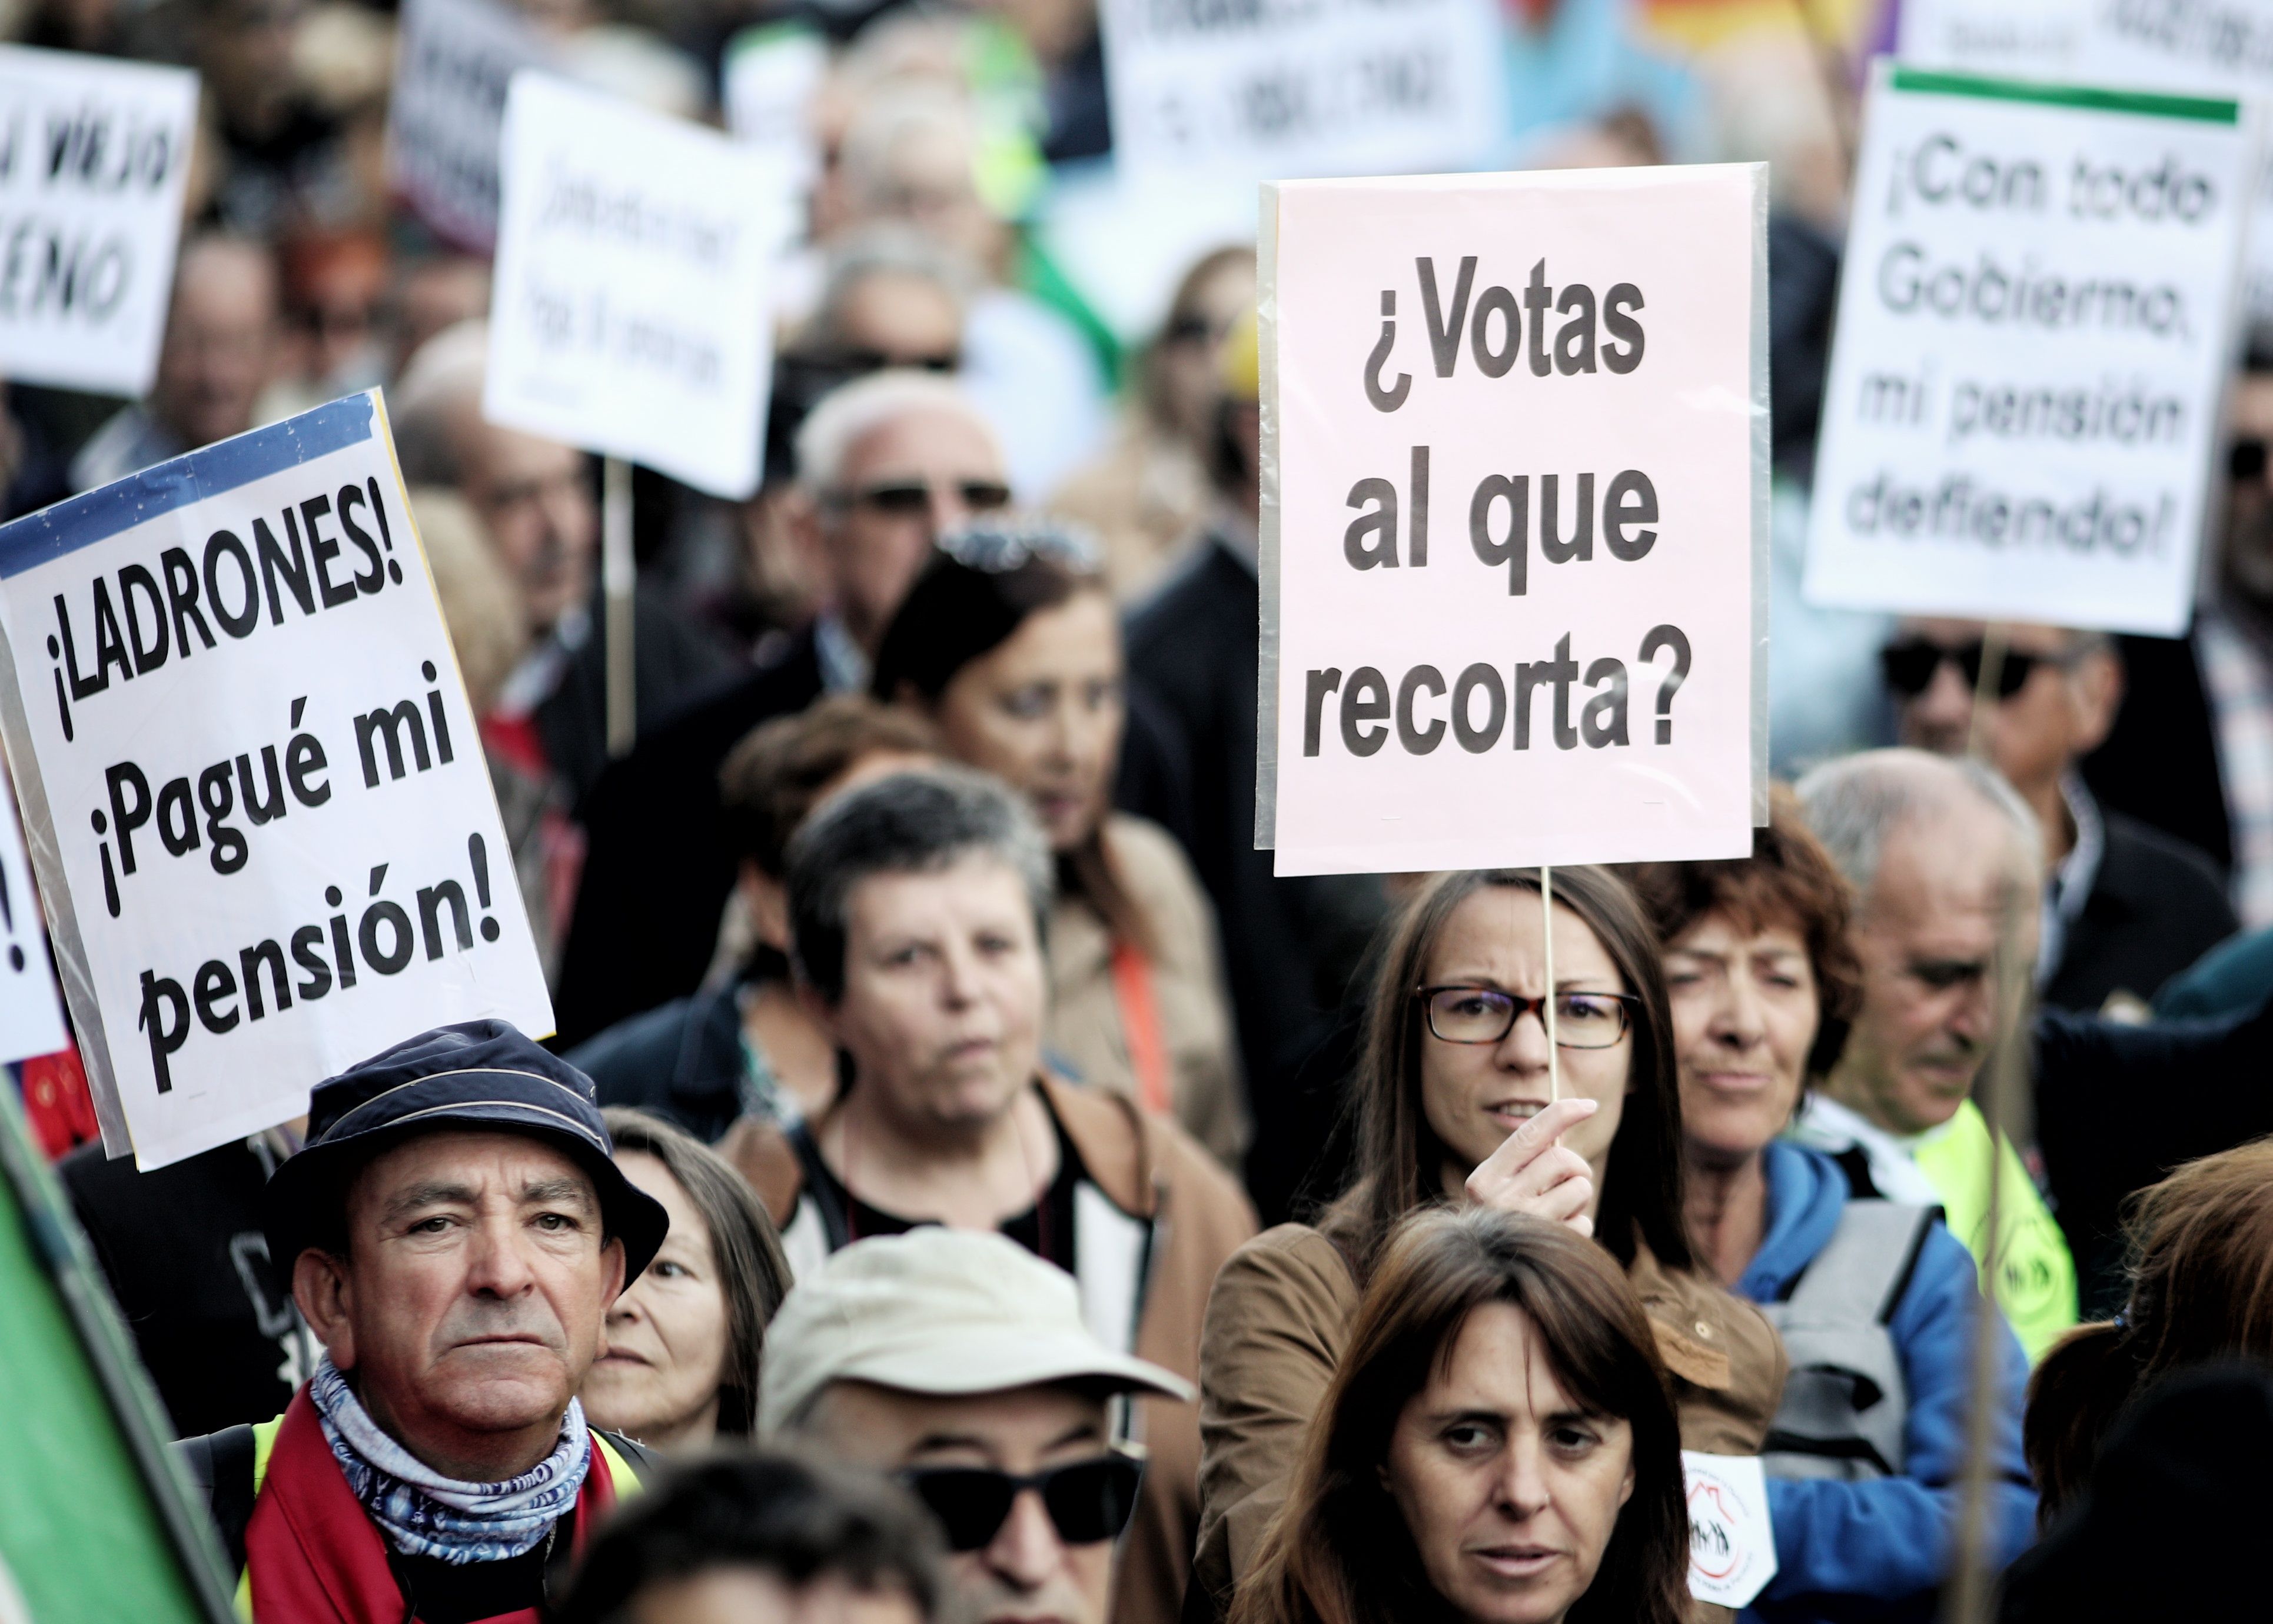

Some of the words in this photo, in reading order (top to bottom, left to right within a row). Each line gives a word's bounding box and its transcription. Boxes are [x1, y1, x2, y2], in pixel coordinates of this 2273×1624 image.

[1886, 133, 2047, 217] ¡Con
[2069, 152, 2214, 223] todo
[1364, 255, 1646, 413] ¿Votas
[1878, 241, 2198, 348] Gobierno,
[1858, 359, 1930, 425] mi
[1946, 372, 2185, 452] pensión
[1343, 445, 1430, 571] al
[1468, 469, 1659, 597] que
[1844, 474, 2179, 561] defiendo!
[47, 476, 403, 743] ¡LADRONES!
[1302, 624, 1692, 758] recorta?
[90, 695, 332, 919] ¡Pagué
[353, 660, 454, 789] mi
[138, 833, 500, 1095] pensión!
